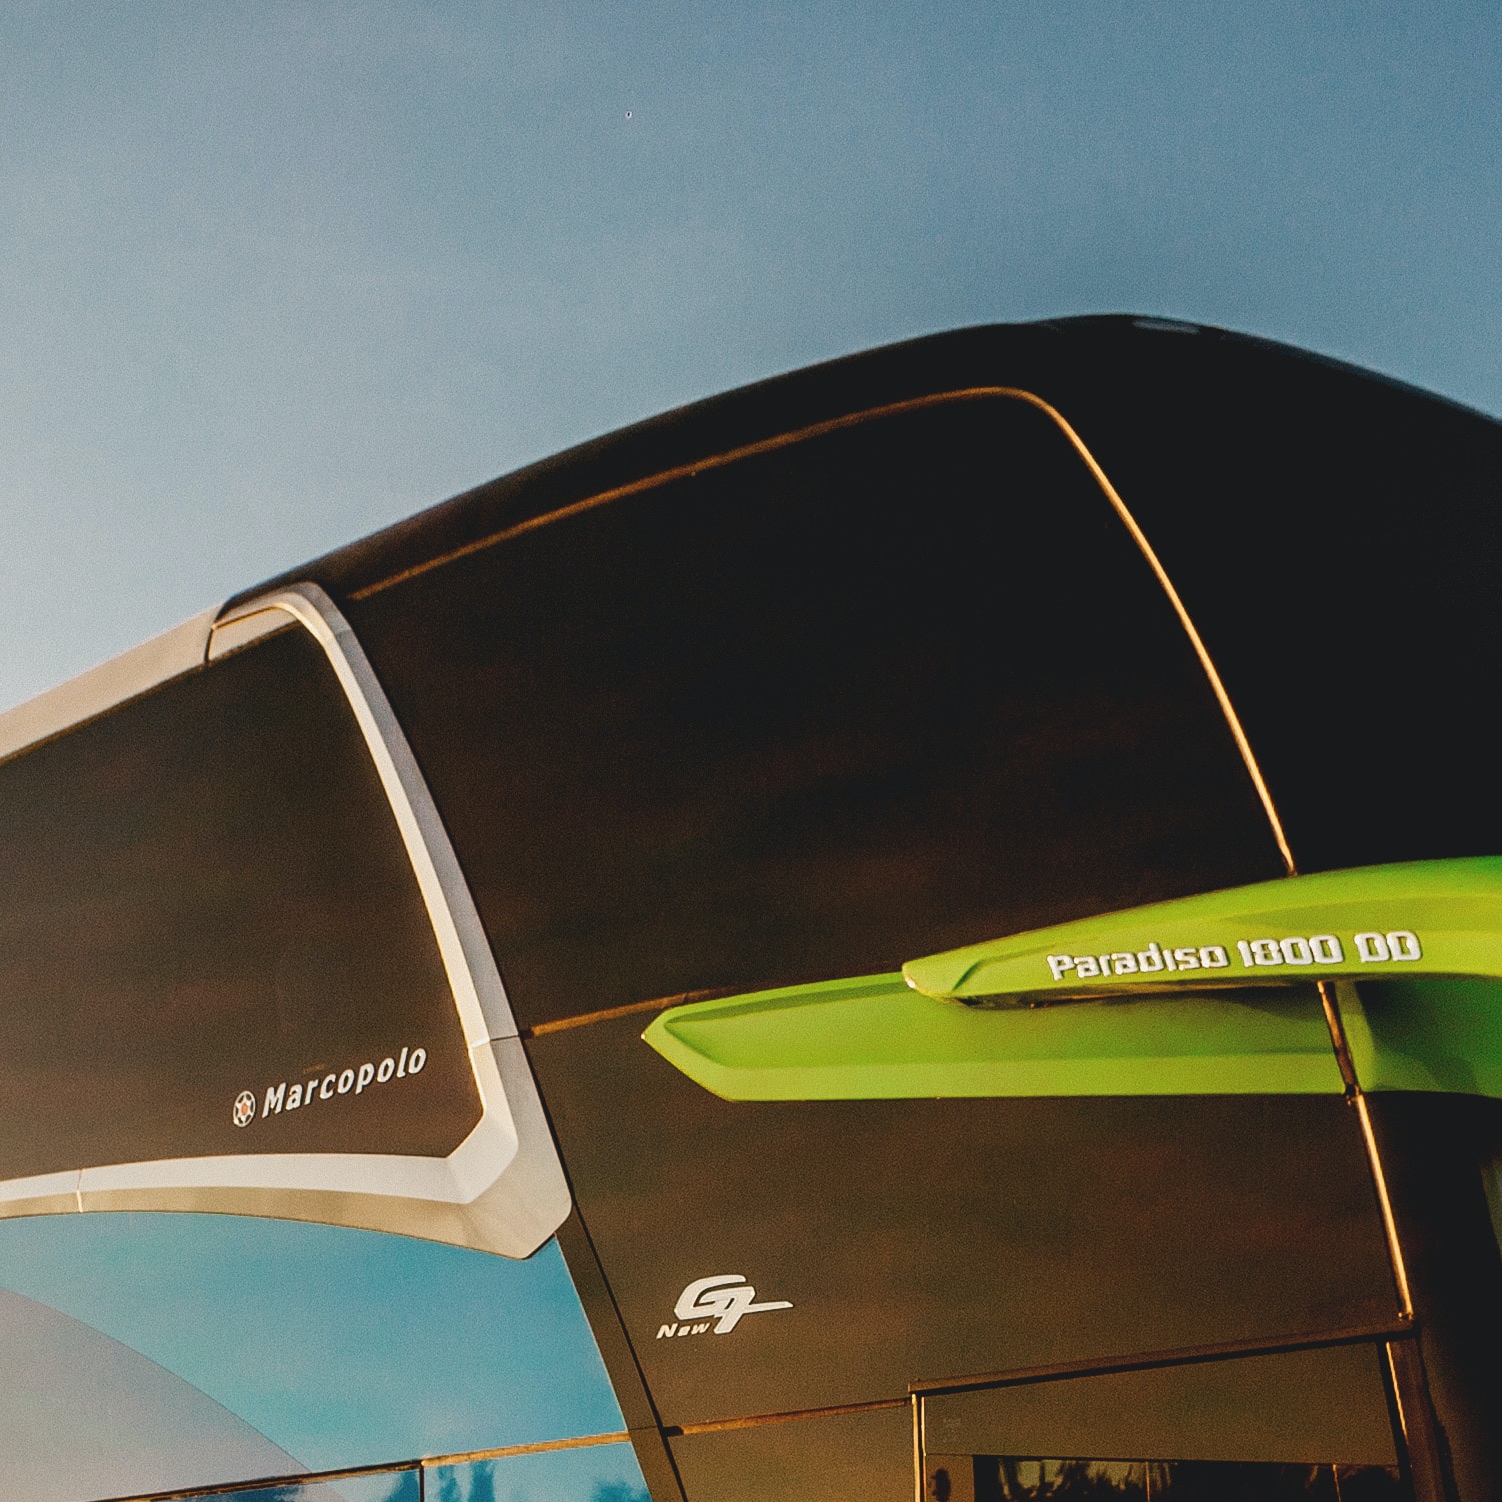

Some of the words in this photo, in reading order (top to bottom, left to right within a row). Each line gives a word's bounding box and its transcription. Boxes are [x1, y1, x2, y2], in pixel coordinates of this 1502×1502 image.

[1047, 942, 1230, 980] Paradiso
[1237, 934, 1344, 968] 1800
[1354, 930, 1422, 963] DD
[261, 1047, 427, 1118] Marcopolo
[656, 1322, 710, 1339] New
